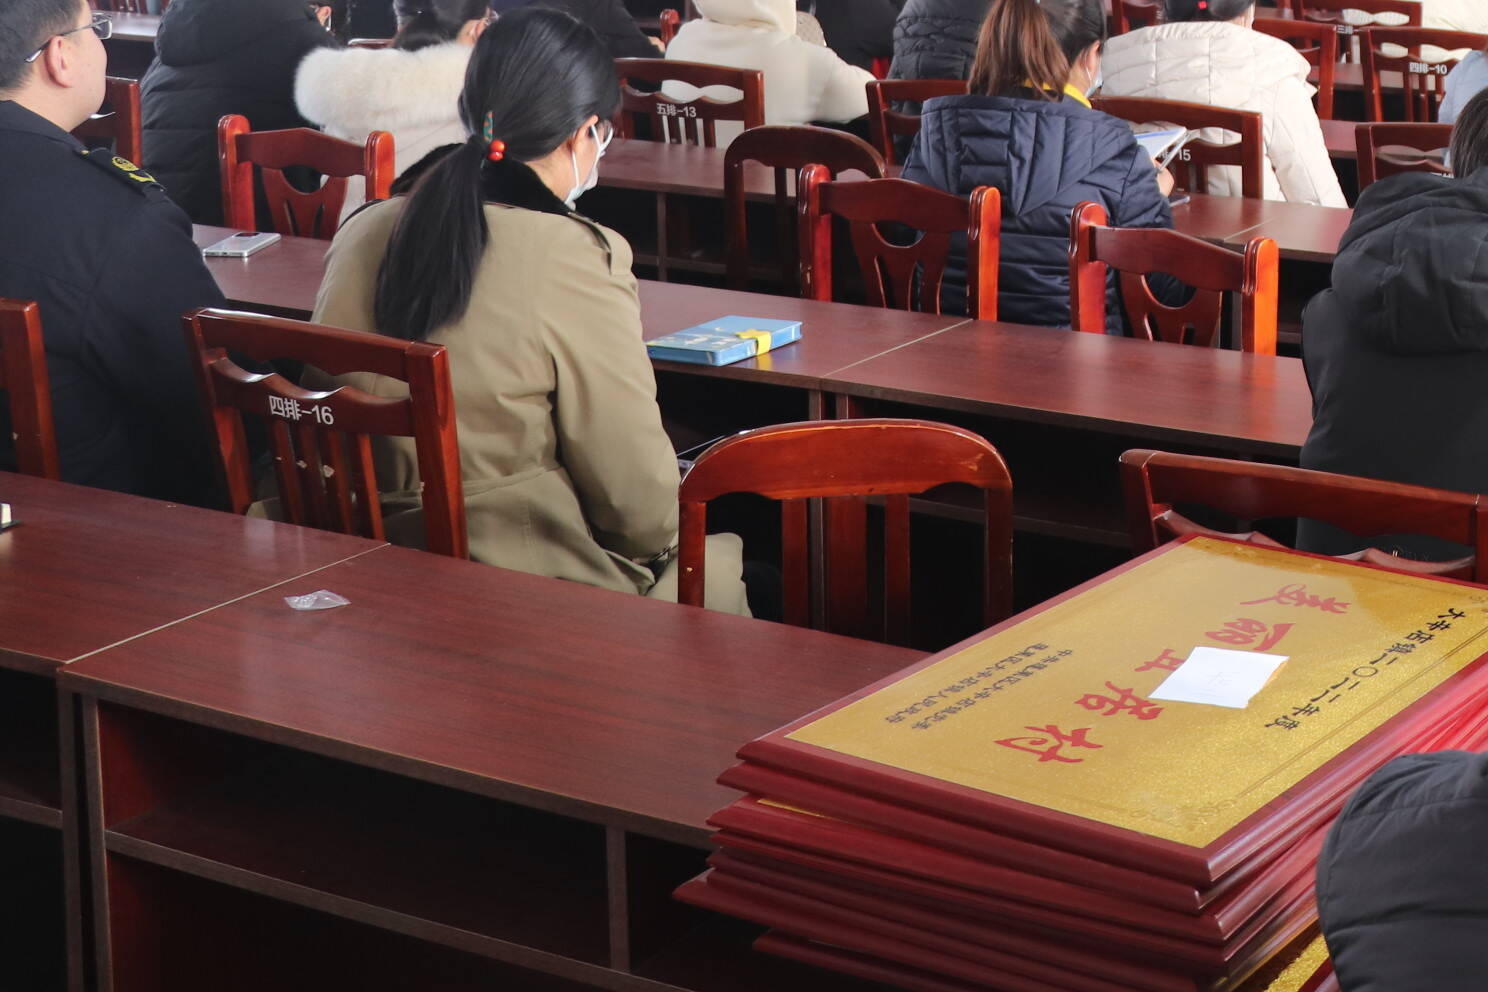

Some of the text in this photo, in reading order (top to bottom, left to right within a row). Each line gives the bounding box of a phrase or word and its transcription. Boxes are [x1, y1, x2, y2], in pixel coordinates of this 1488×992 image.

[1408, 61, 1448, 75] 四排-10
[656, 103, 697, 117] 五排-13
[268, 395, 334, 425] 四排-16
